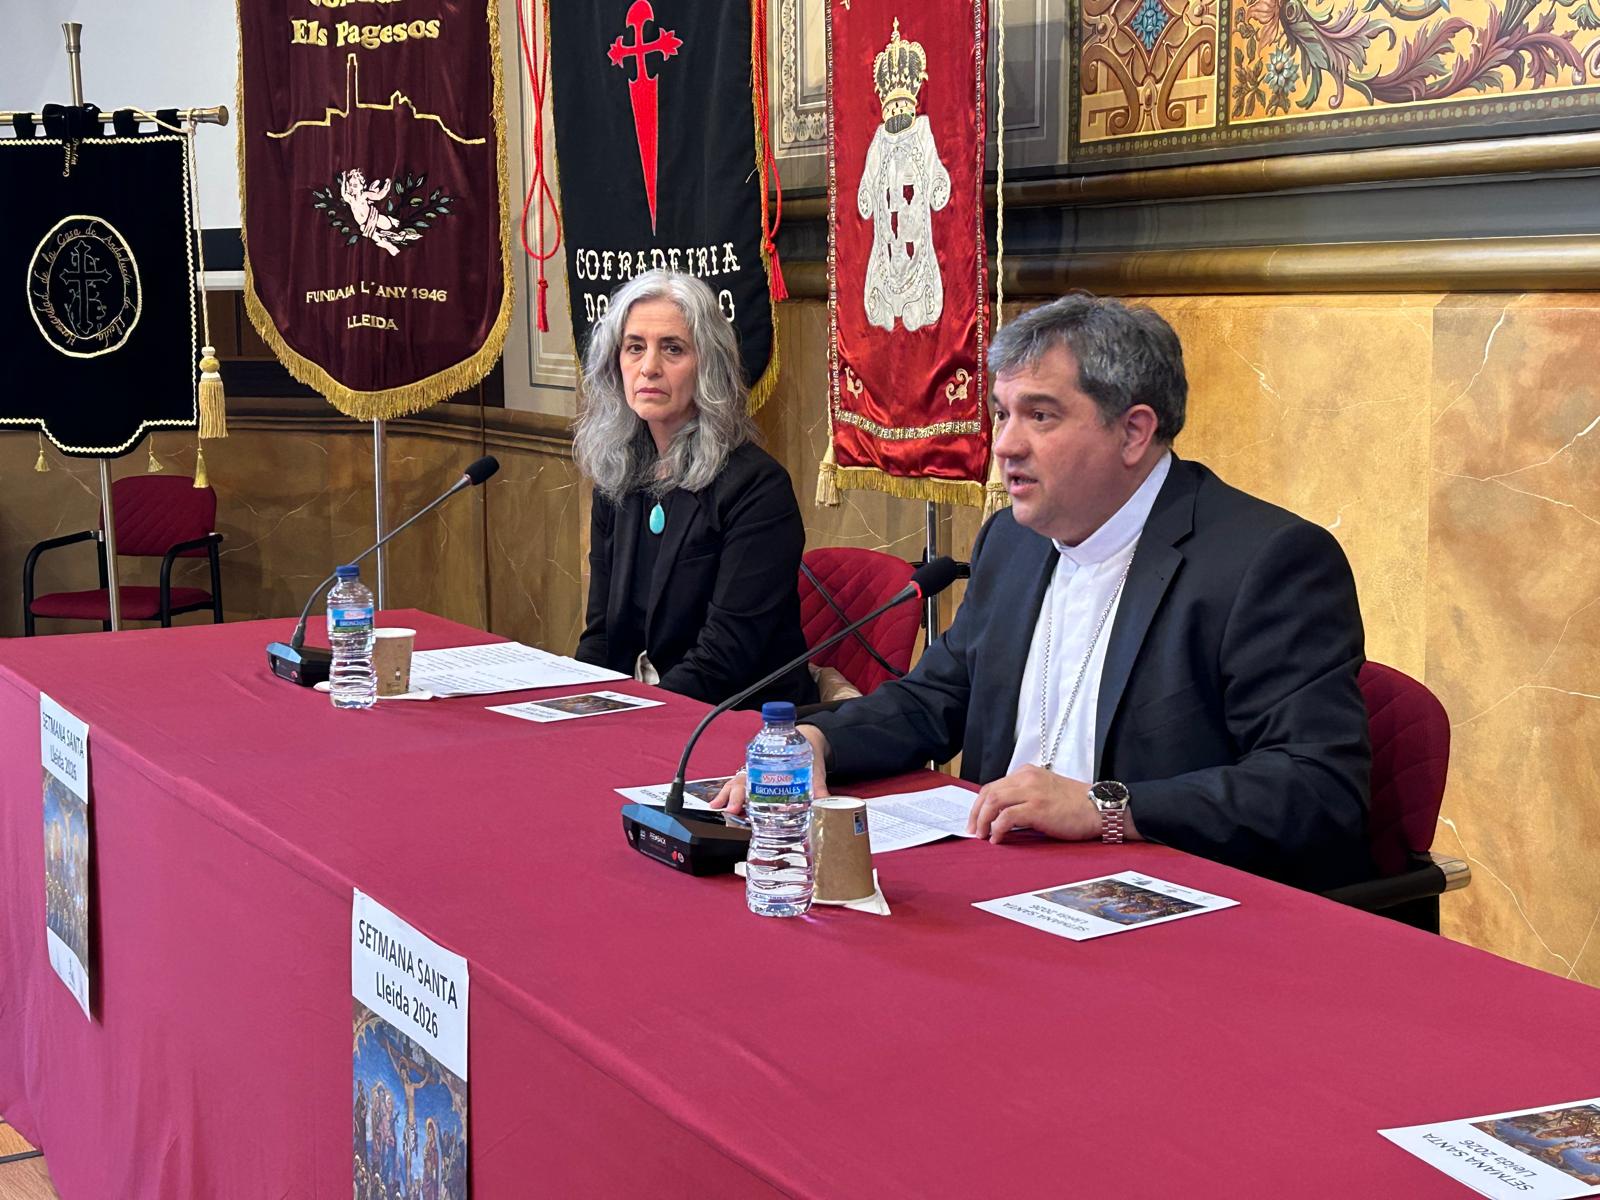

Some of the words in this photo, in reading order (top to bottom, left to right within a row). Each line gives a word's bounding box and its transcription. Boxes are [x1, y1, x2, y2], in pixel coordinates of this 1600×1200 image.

[291, 19, 328, 47] Els
[335, 19, 441, 50] Pagesos
[56, 228, 81, 246] Casa
[85, 220, 101, 236] de
[411, 287, 448, 302] 1946
[347, 314, 399, 331] LLEIDA
[755, 786, 801, 795] BRONCHALES
[358, 919, 415, 978] SETMANA
[417, 958, 458, 1009] SANTA
[376, 971, 410, 1017] Lleida
[412, 996, 438, 1039] 2026
[1421, 1132, 1470, 1160] SANTA
[1458, 1138, 1497, 1157] 2026
[1465, 1155, 1535, 1191] SETMANA
[1494, 1155, 1538, 1178] Lleida
